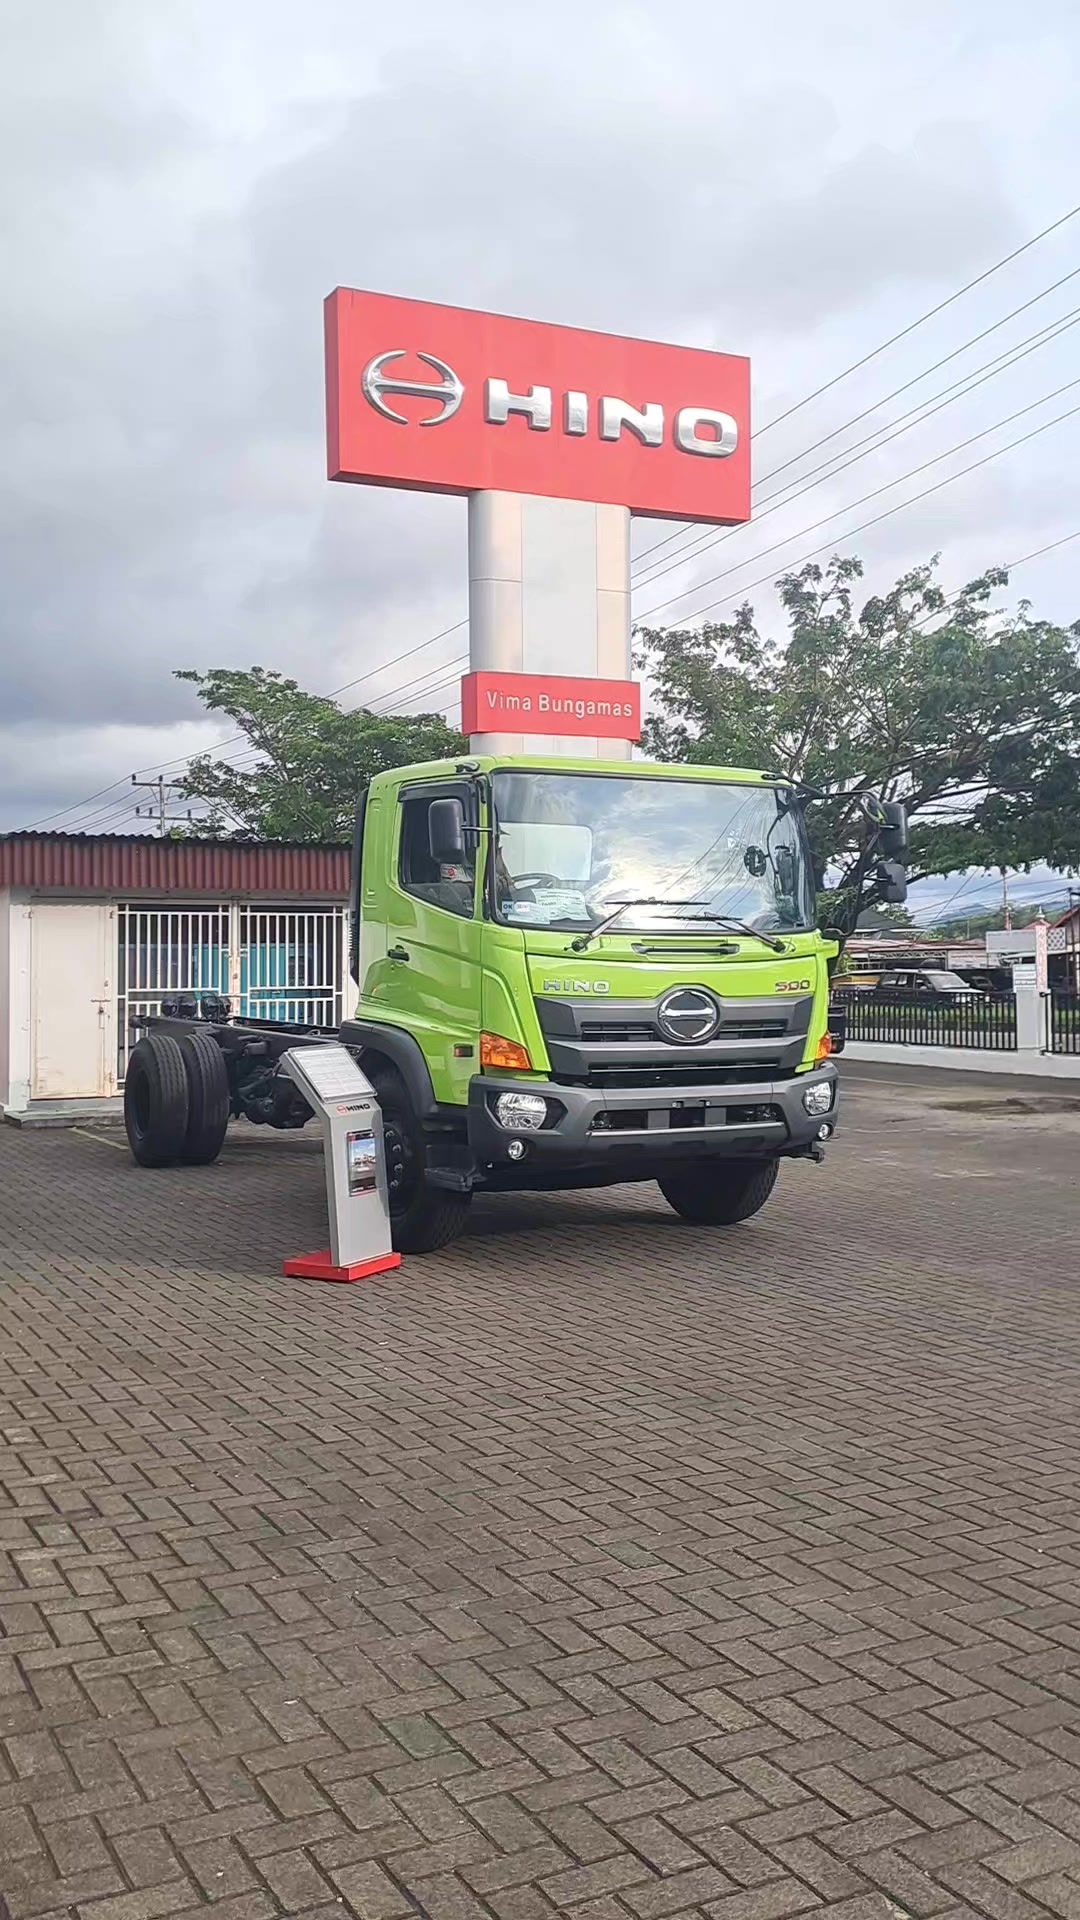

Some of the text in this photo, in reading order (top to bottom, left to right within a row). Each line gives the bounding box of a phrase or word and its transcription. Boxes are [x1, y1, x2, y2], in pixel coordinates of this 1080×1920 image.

[485, 377, 739, 458] HINO
[486, 690, 633, 719] Vima Bungamas
[543, 979, 610, 994] HINO
[775, 979, 810, 993] 500
[346, 1103, 371, 1112] HINO
